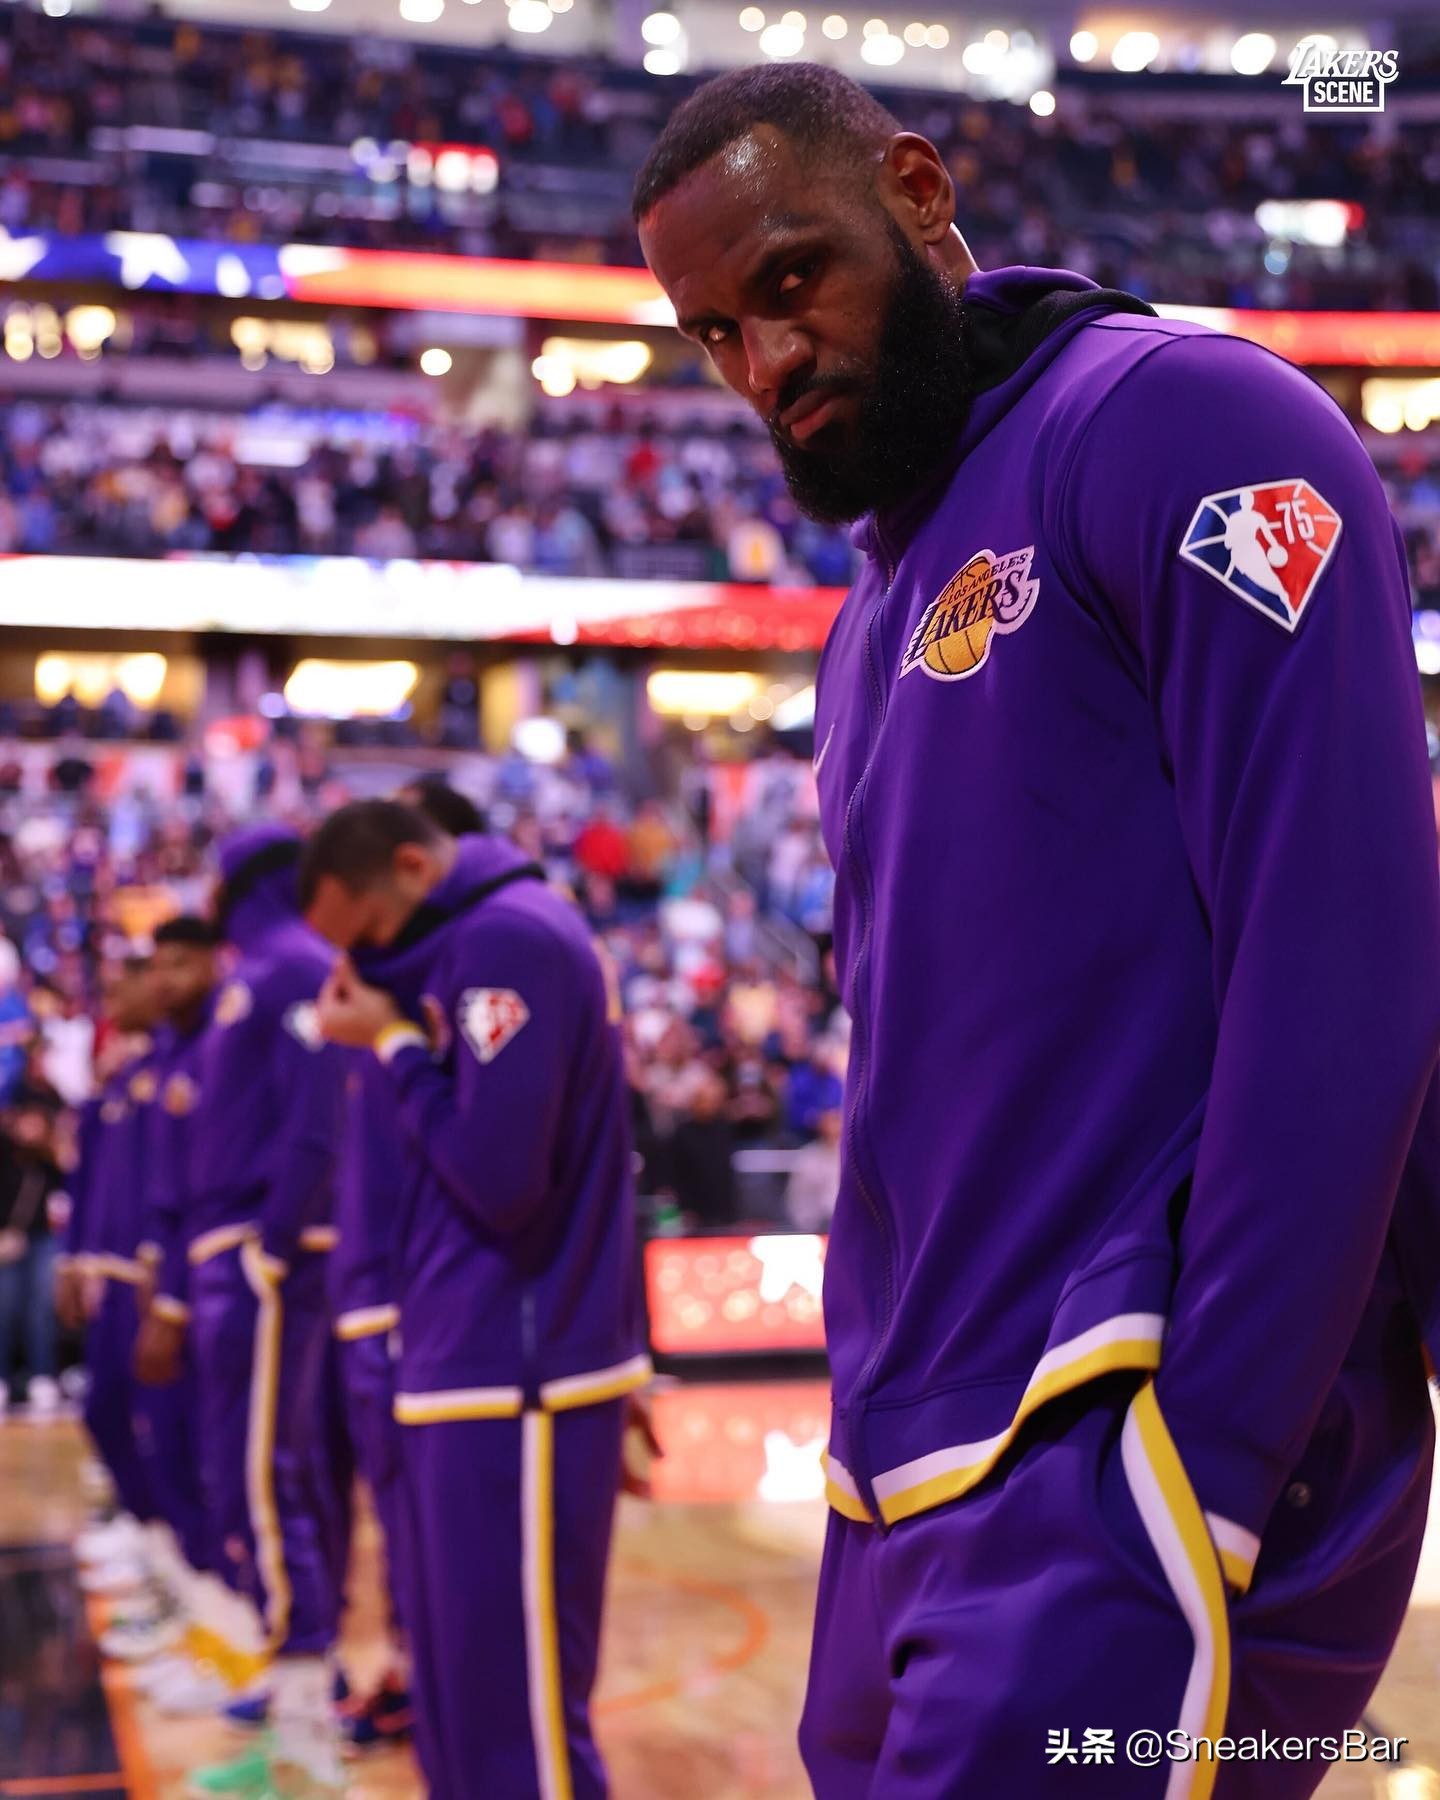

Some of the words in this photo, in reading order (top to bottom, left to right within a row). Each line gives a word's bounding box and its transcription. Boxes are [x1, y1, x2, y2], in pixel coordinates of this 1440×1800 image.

[1275, 499, 1315, 544] 75
[947, 587, 967, 604] LOS
[968, 553, 1028, 590] ANGELES
[904, 570, 1033, 669] LAKERS
